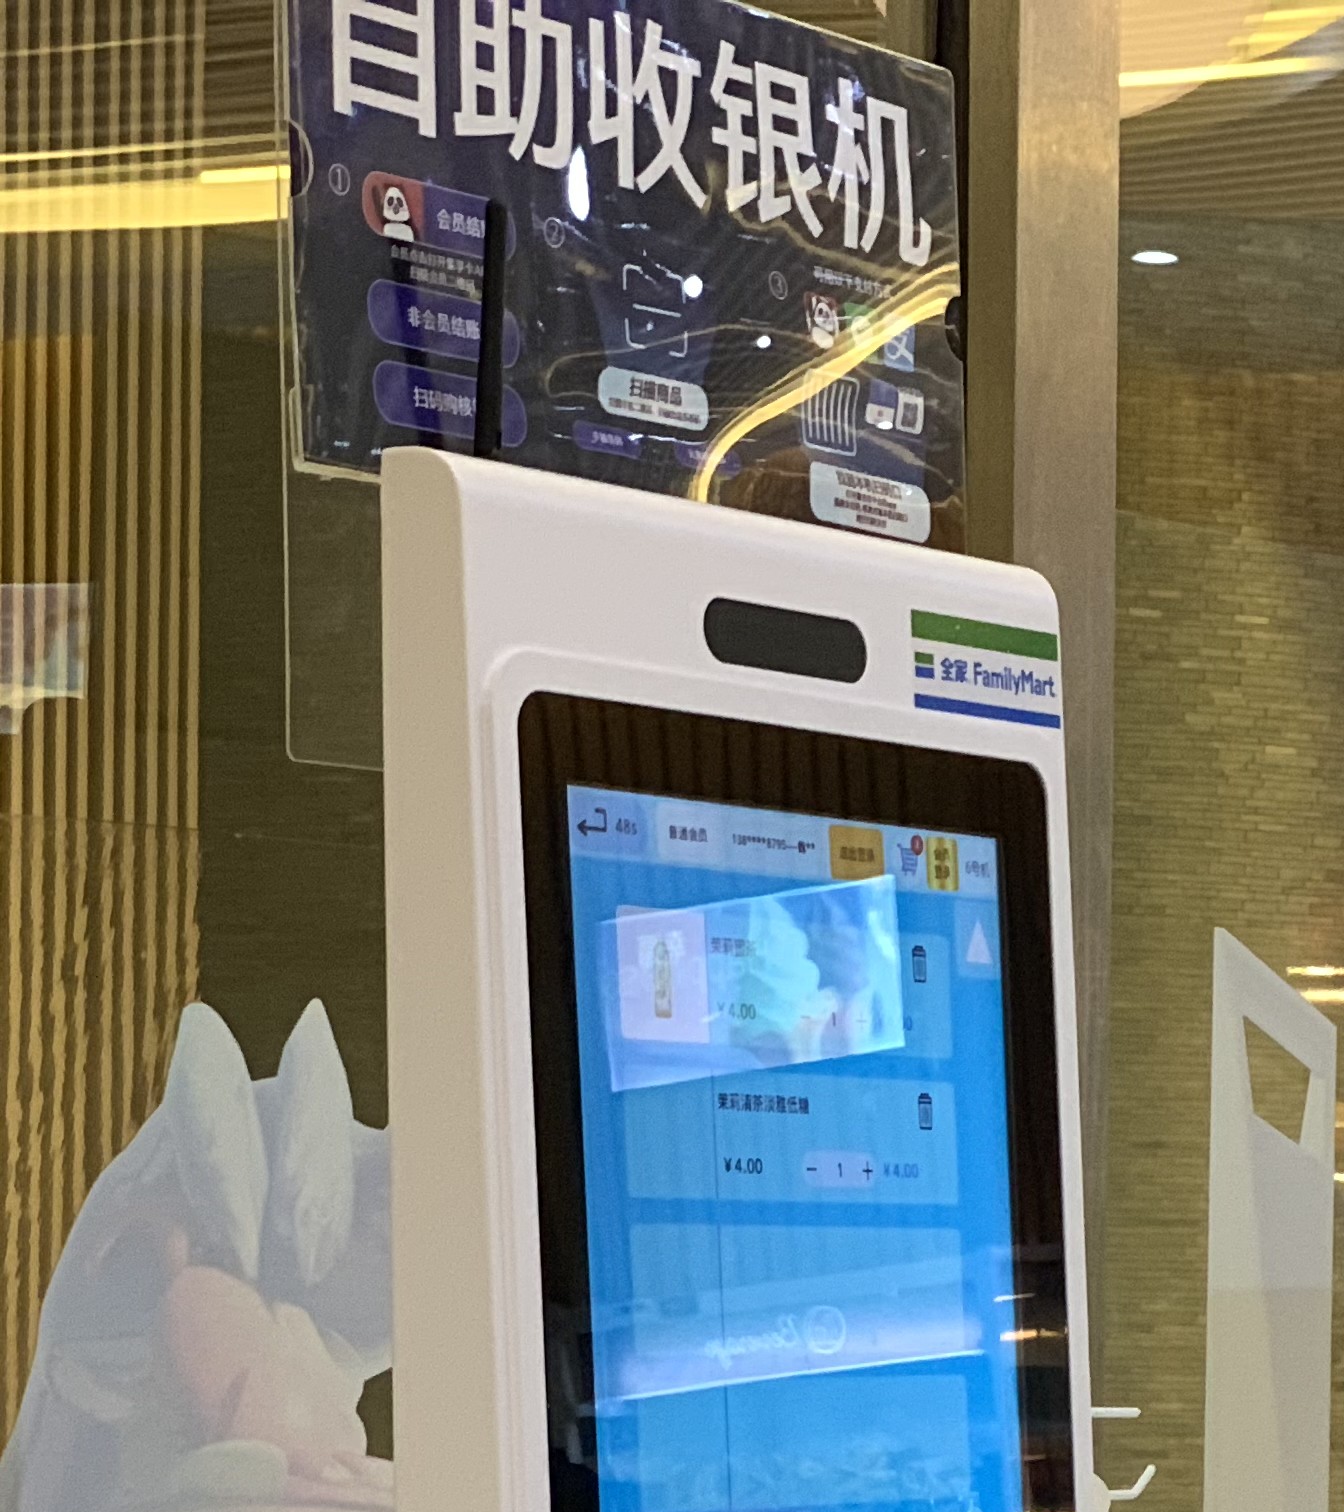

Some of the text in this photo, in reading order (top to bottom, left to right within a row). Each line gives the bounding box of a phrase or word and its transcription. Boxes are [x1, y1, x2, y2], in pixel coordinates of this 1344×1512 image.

[332, 0, 932, 267] 自助收银机
[437, 208, 485, 238] 会员结
[940, 657, 1055, 698] 全家 FamilyMart
[723, 1157, 763, 1176] ¥4.00
